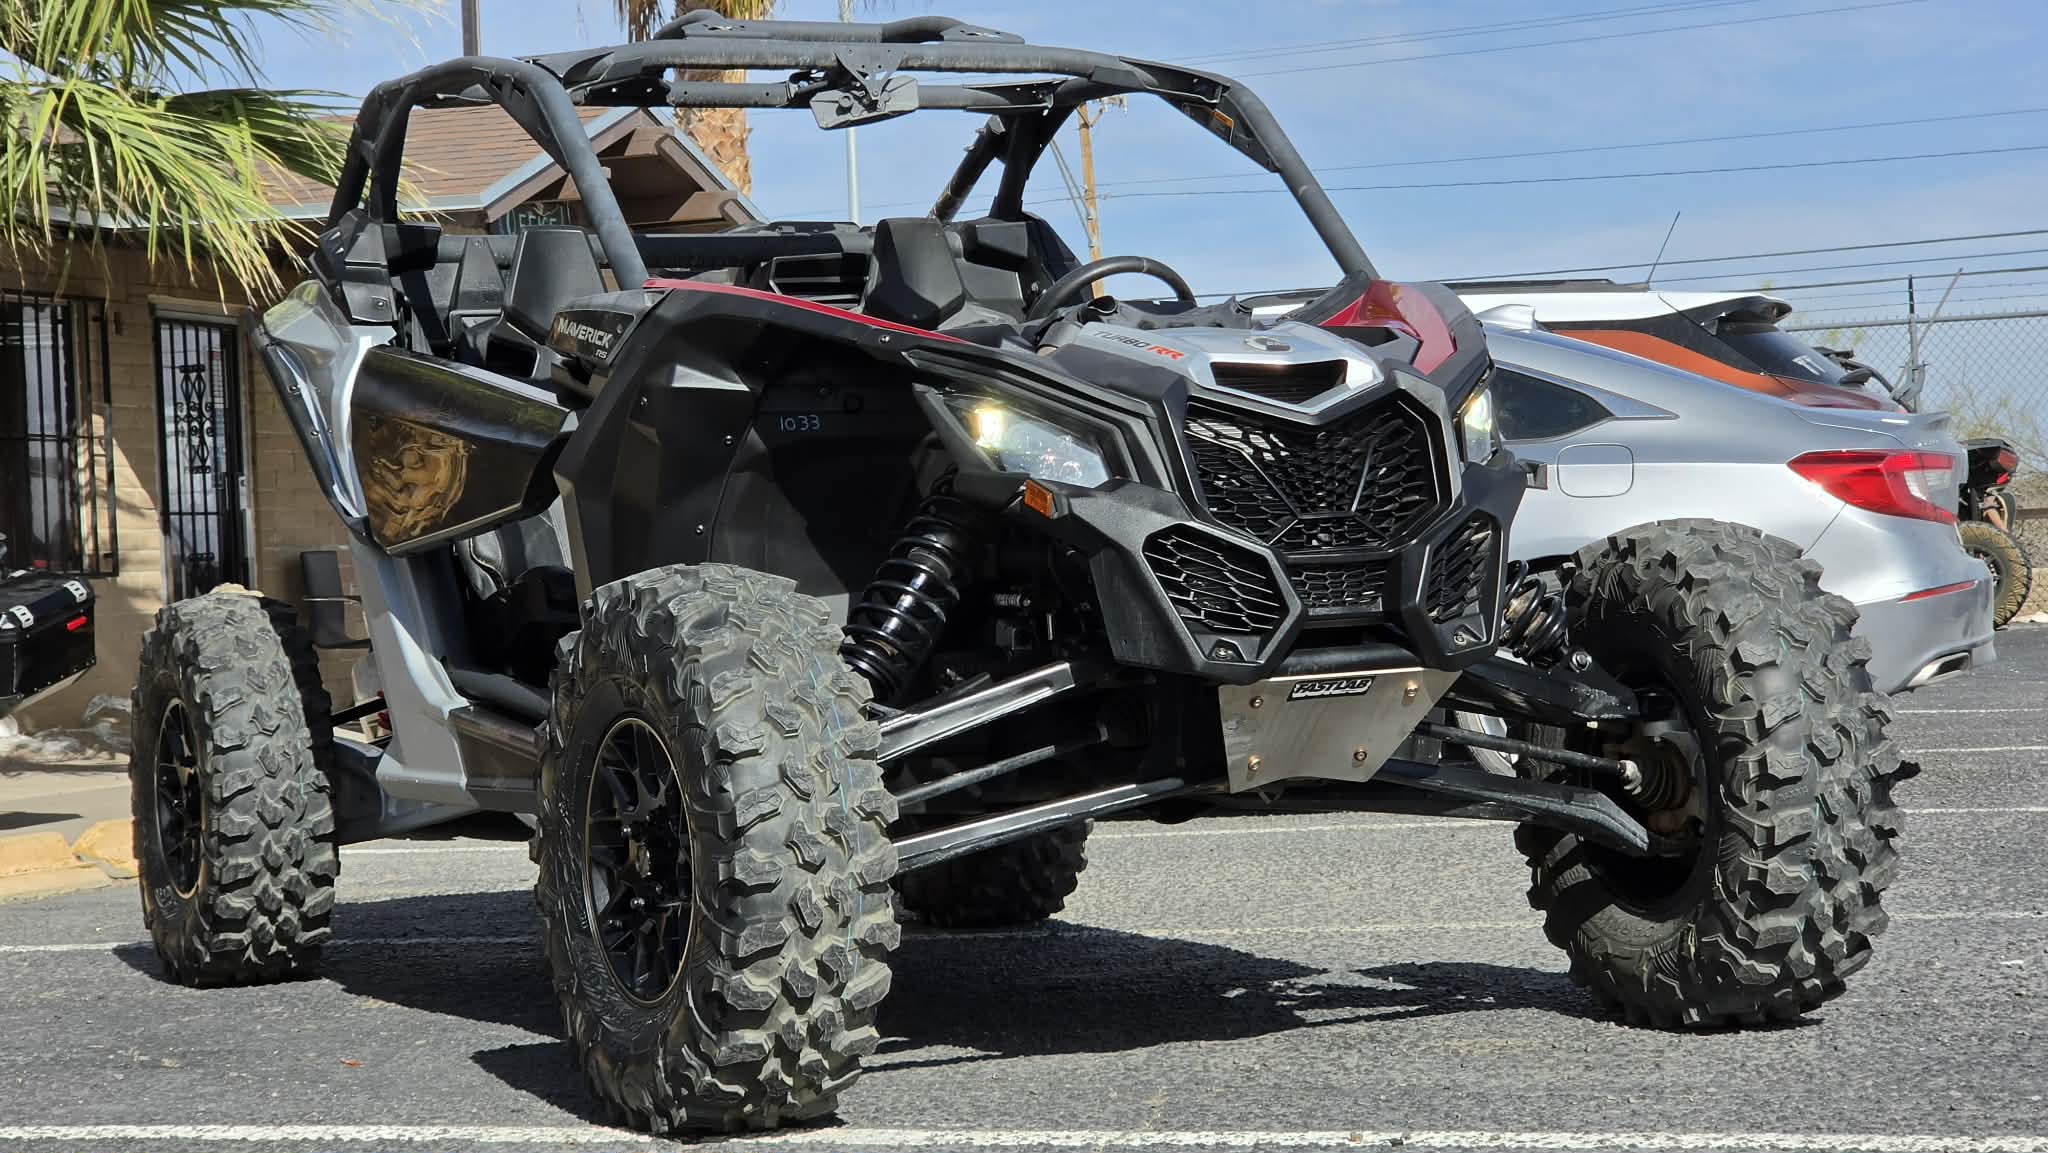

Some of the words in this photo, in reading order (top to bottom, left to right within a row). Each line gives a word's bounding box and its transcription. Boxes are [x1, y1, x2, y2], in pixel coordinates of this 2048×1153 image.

[558, 317, 613, 348] MAVERICK
[595, 348, 608, 359] RS
[780, 414, 820, 433] 1033
[1292, 679, 1371, 696] FASTLAB
